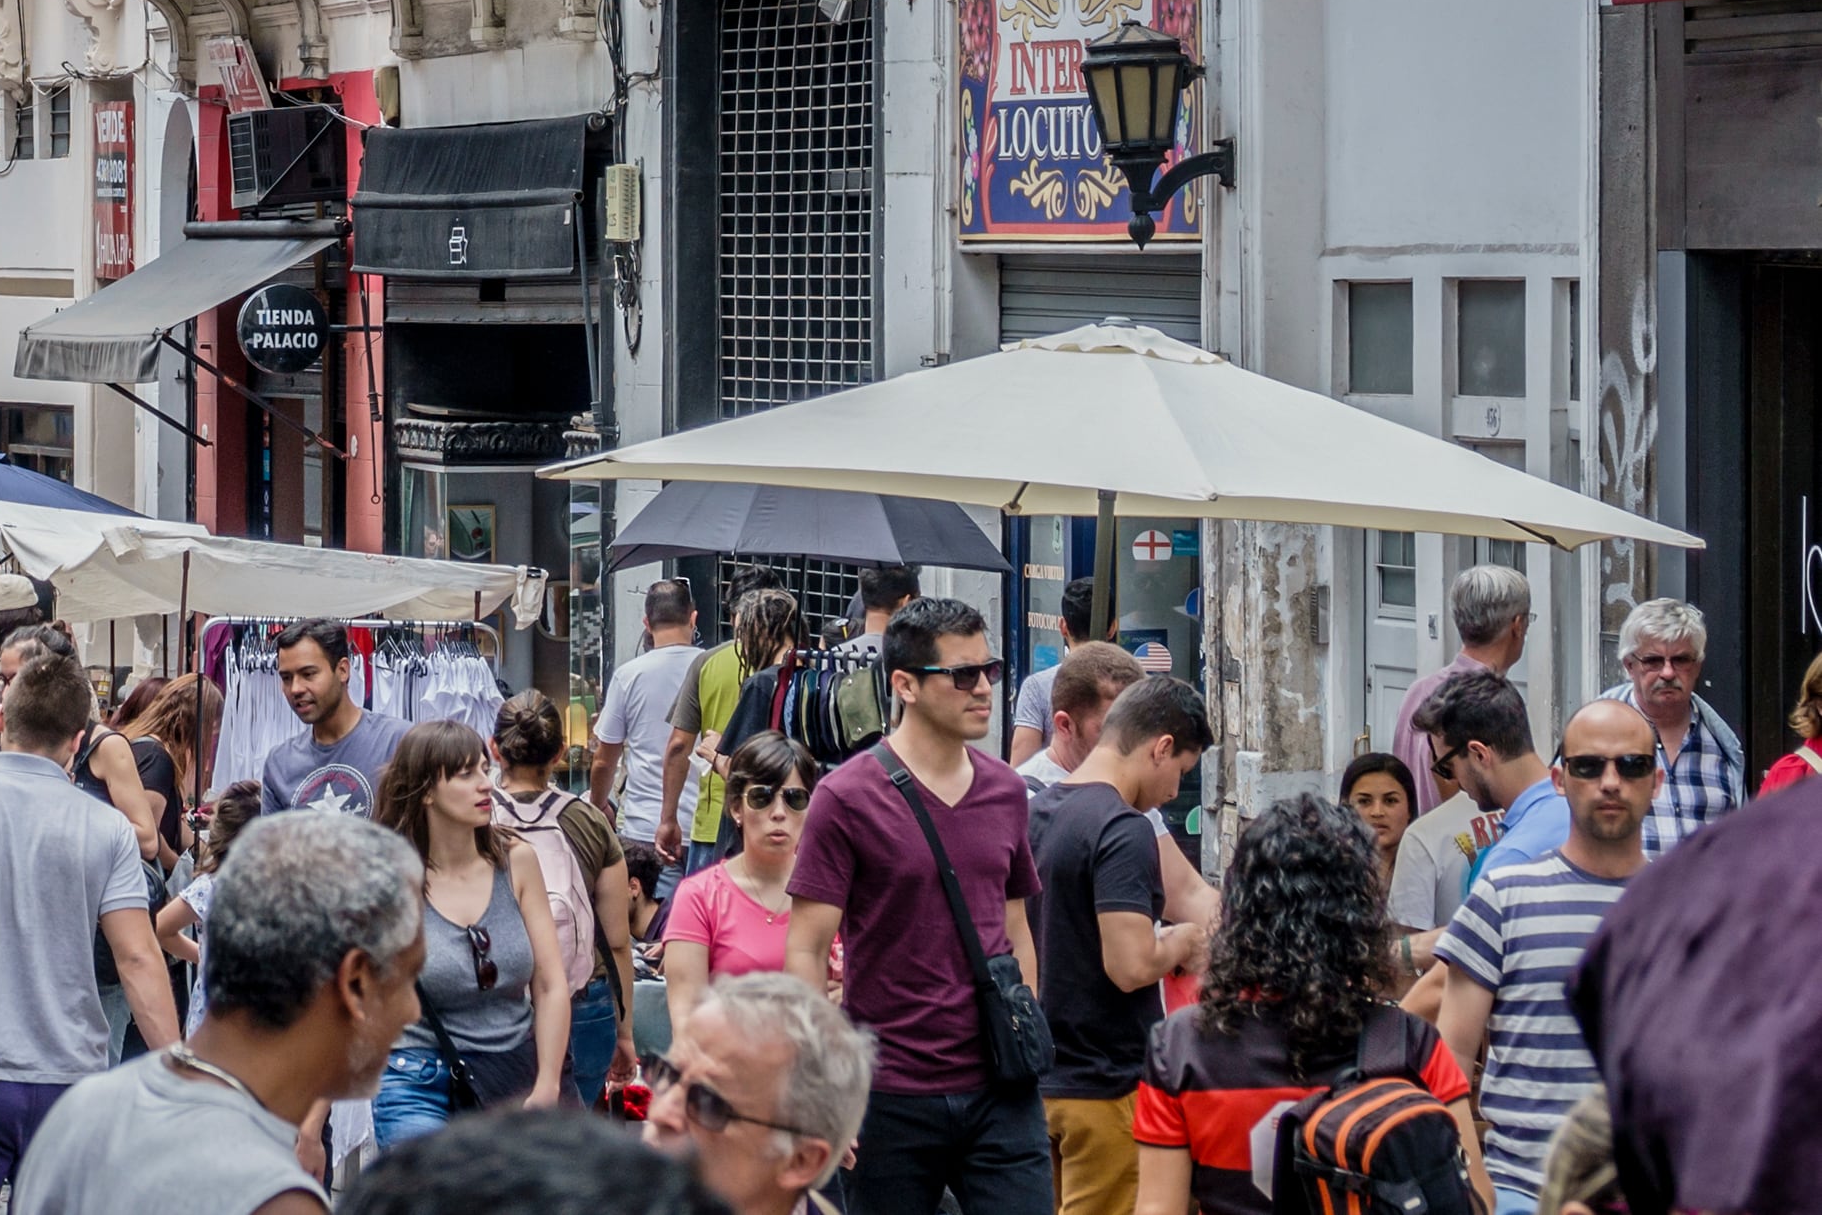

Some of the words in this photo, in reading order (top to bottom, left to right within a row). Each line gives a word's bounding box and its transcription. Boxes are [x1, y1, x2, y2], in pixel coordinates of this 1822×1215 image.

[1009, 39, 1091, 95] INTER
[998, 104, 1113, 160] LOCUTO
[256, 309, 315, 325] TIENDA
[253, 332, 318, 348] PALACIO
